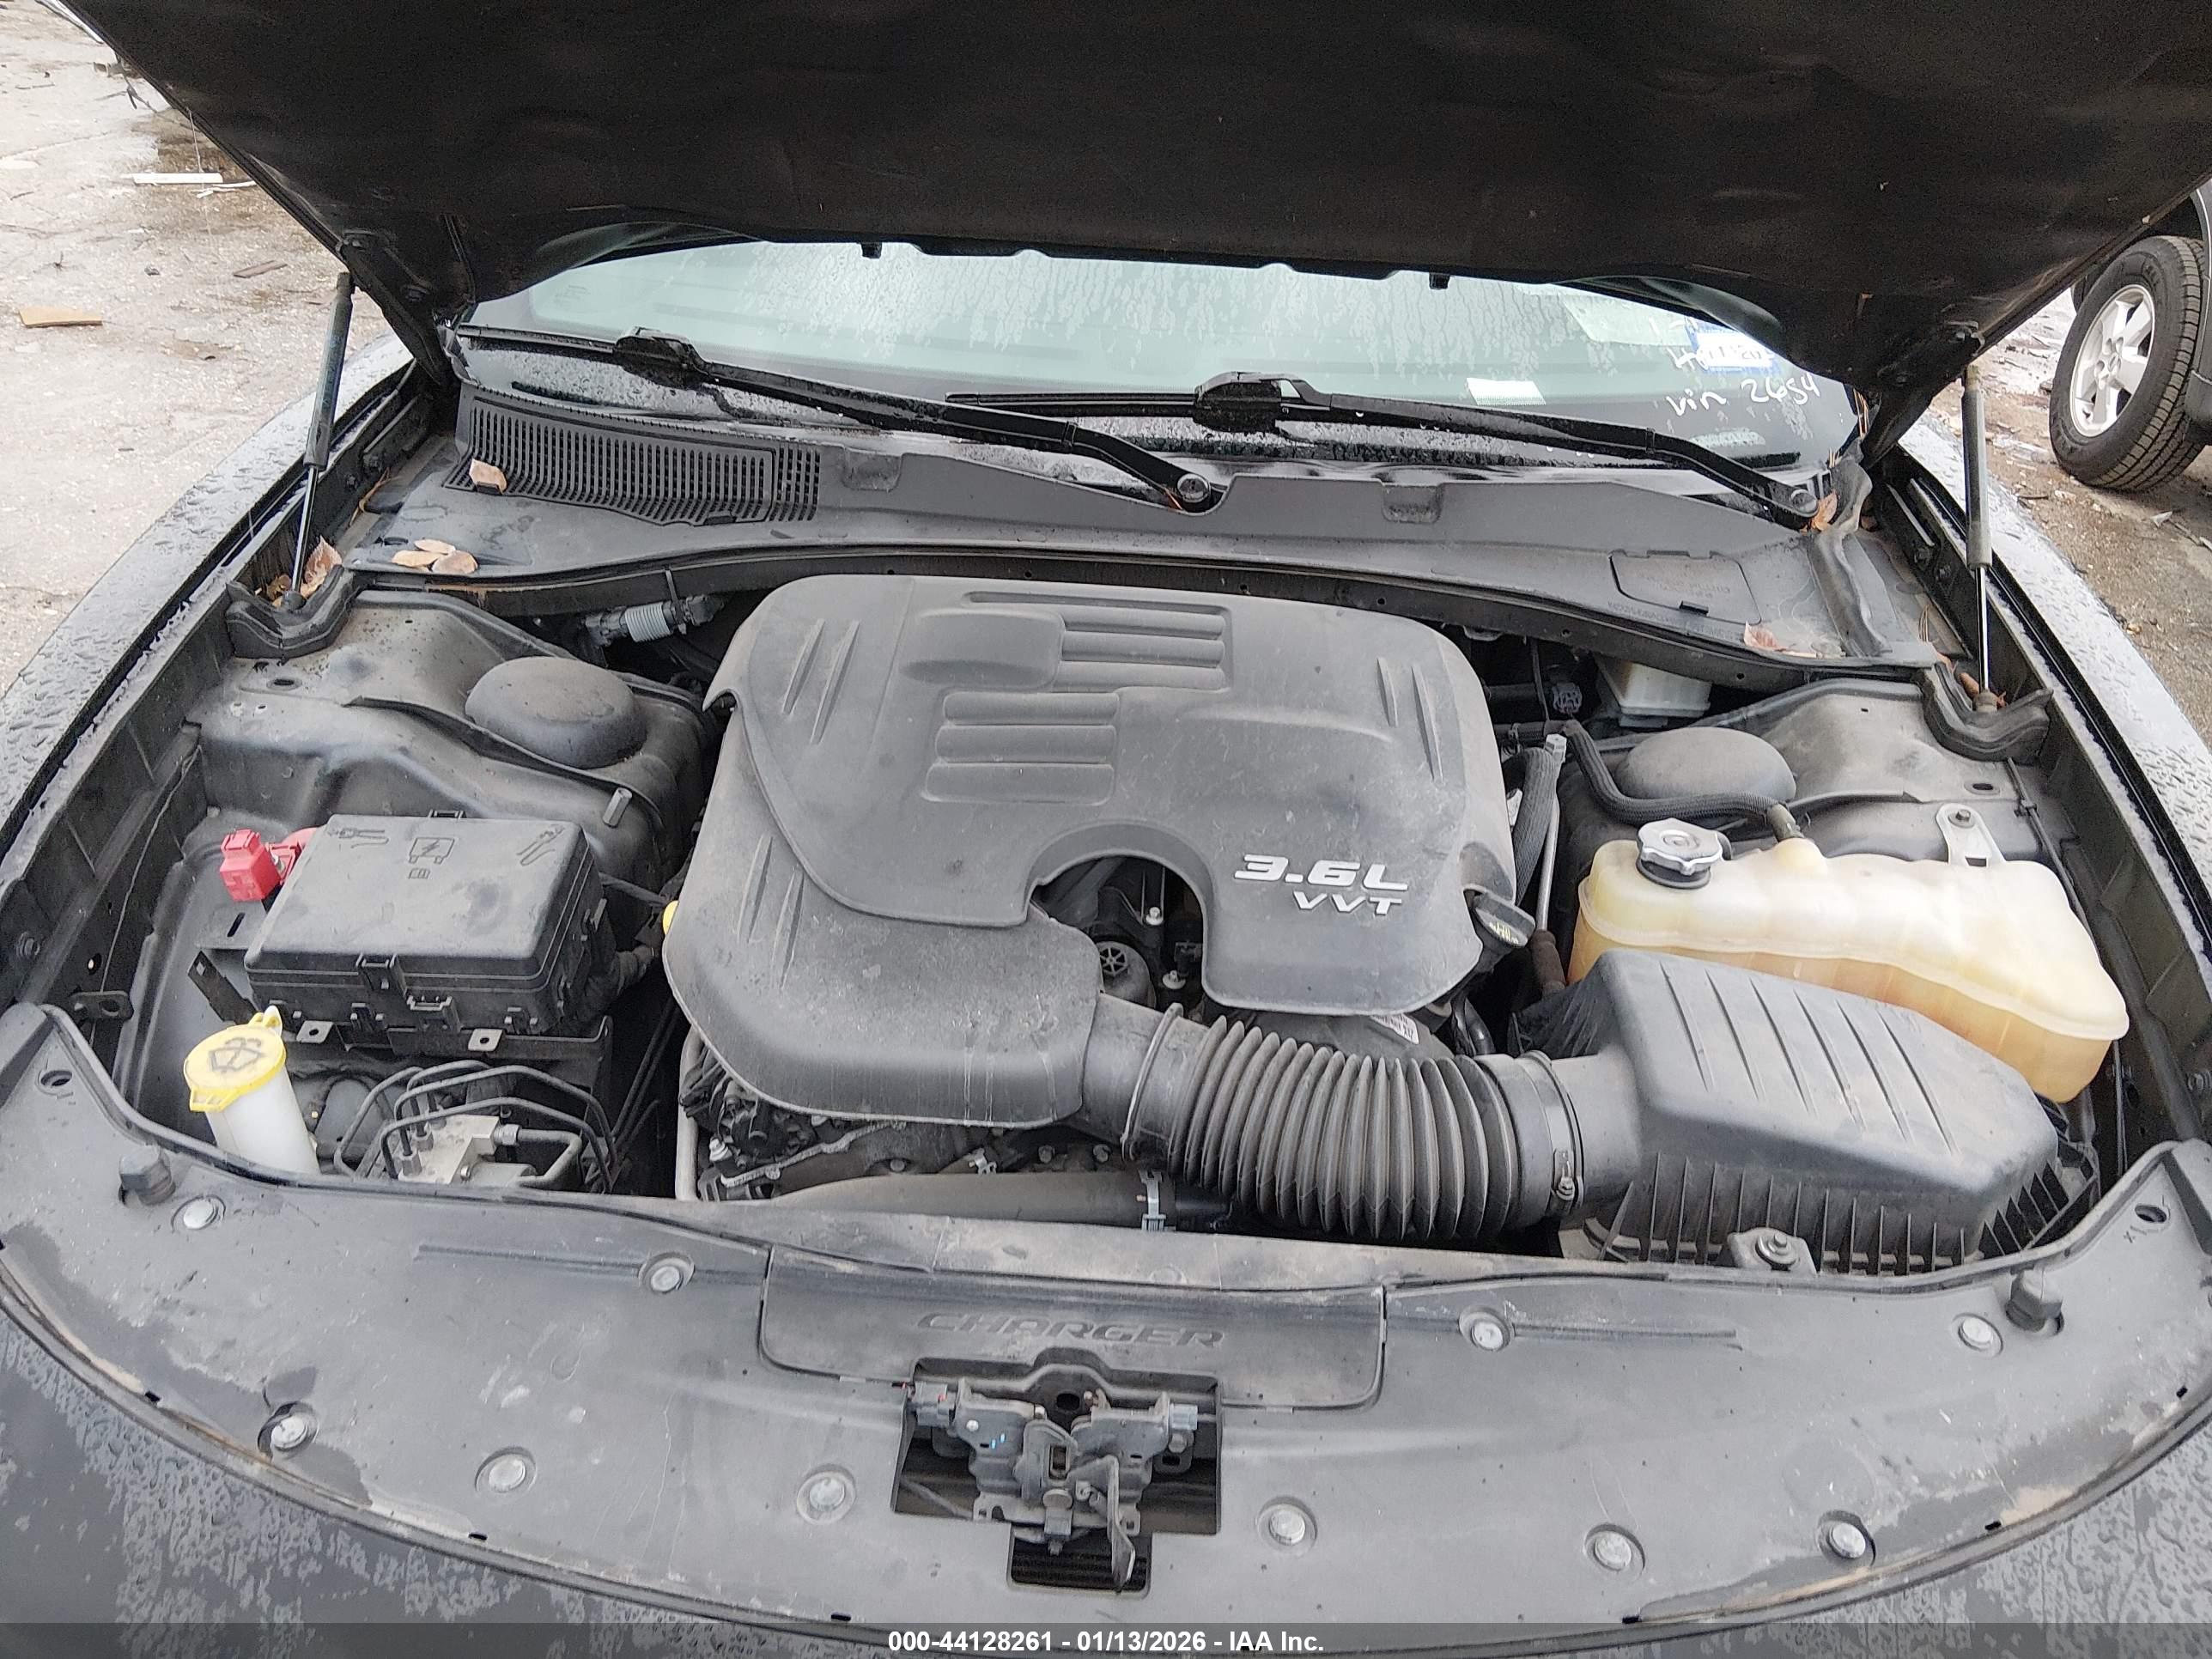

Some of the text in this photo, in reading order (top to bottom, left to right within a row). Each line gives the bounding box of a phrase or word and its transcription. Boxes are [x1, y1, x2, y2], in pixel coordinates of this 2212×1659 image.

[1234, 854, 1408, 890] 3.6L
[1293, 890, 1402, 915] VVT
[917, 1312, 1224, 1347] CHARGER
